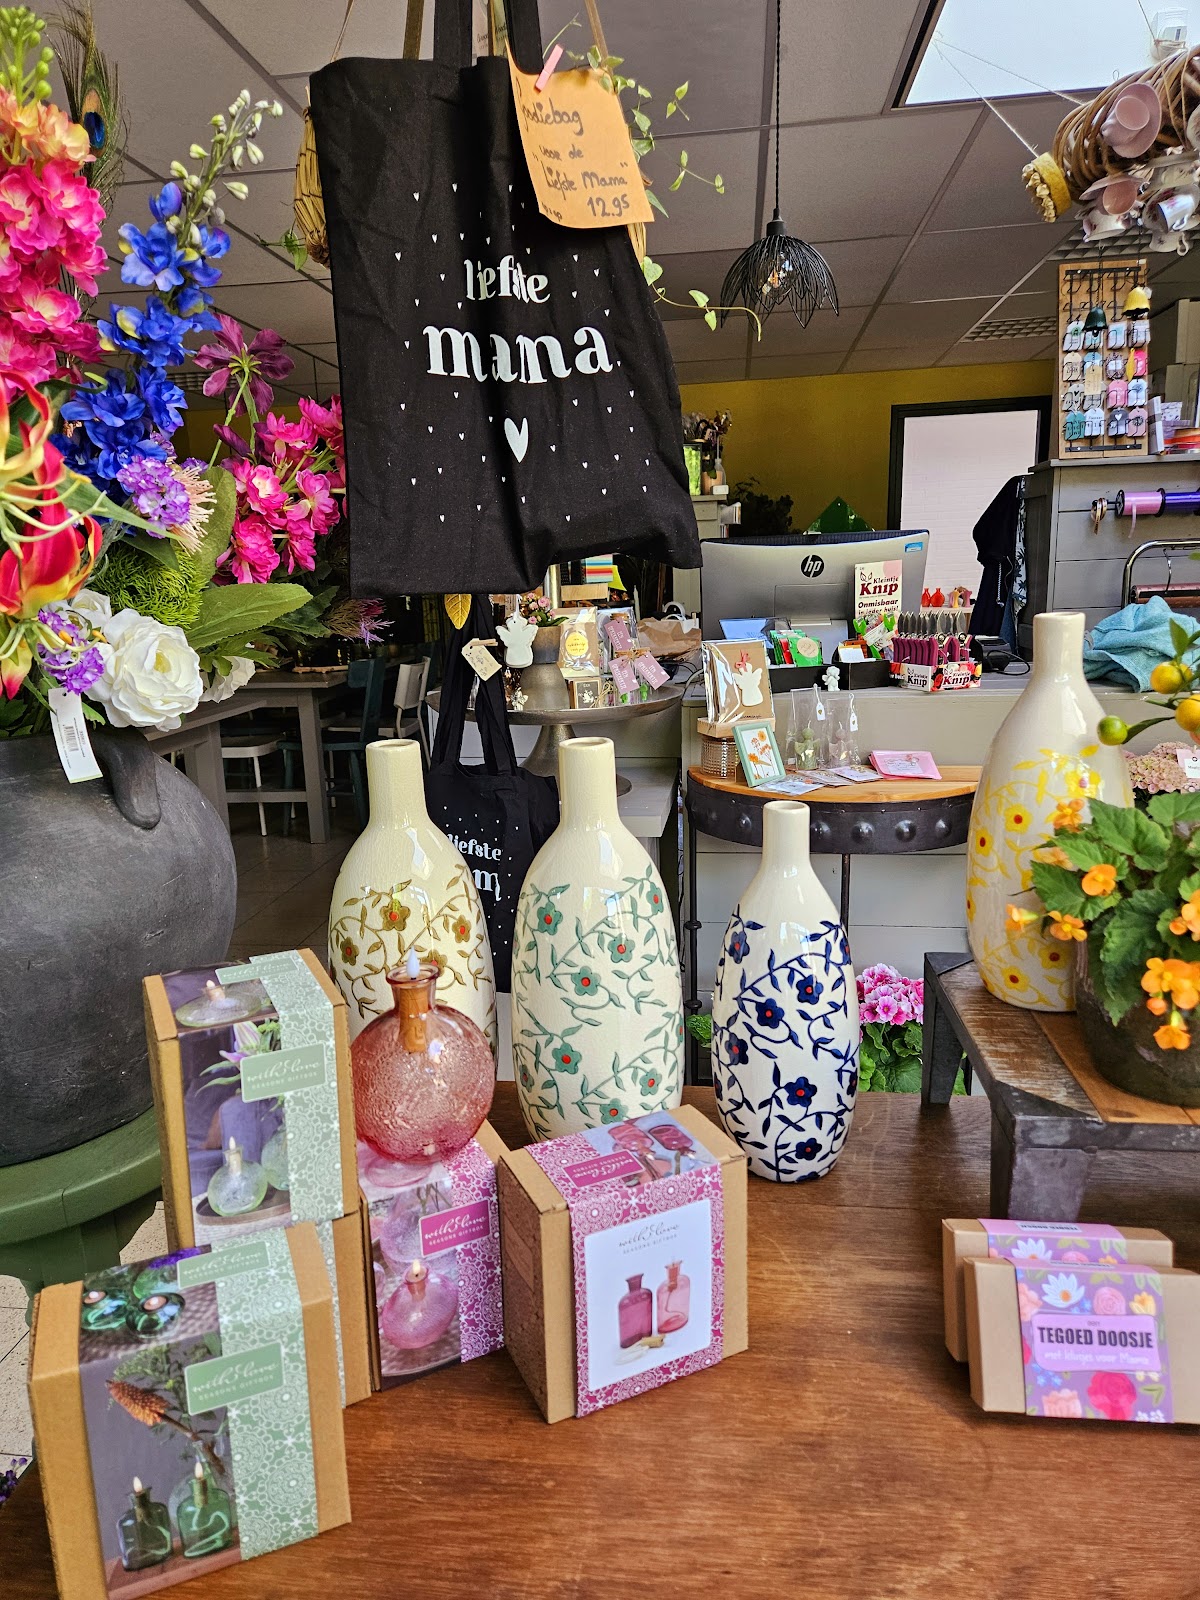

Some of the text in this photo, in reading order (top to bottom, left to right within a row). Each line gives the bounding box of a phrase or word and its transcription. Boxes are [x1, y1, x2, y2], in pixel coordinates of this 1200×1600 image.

[568, 144, 584, 159] de
[464, 254, 551, 303] liefste
[422, 325, 614, 384] mama
[802, 555, 824, 577] hp
[860, 582, 899, 595] Knip
[858, 599, 899, 608] Onmisbaar
[907, 675, 928, 688] Knip
[943, 676, 970, 686] Knip
[1037, 1326, 1154, 1349] TEGOED DOOSJE
